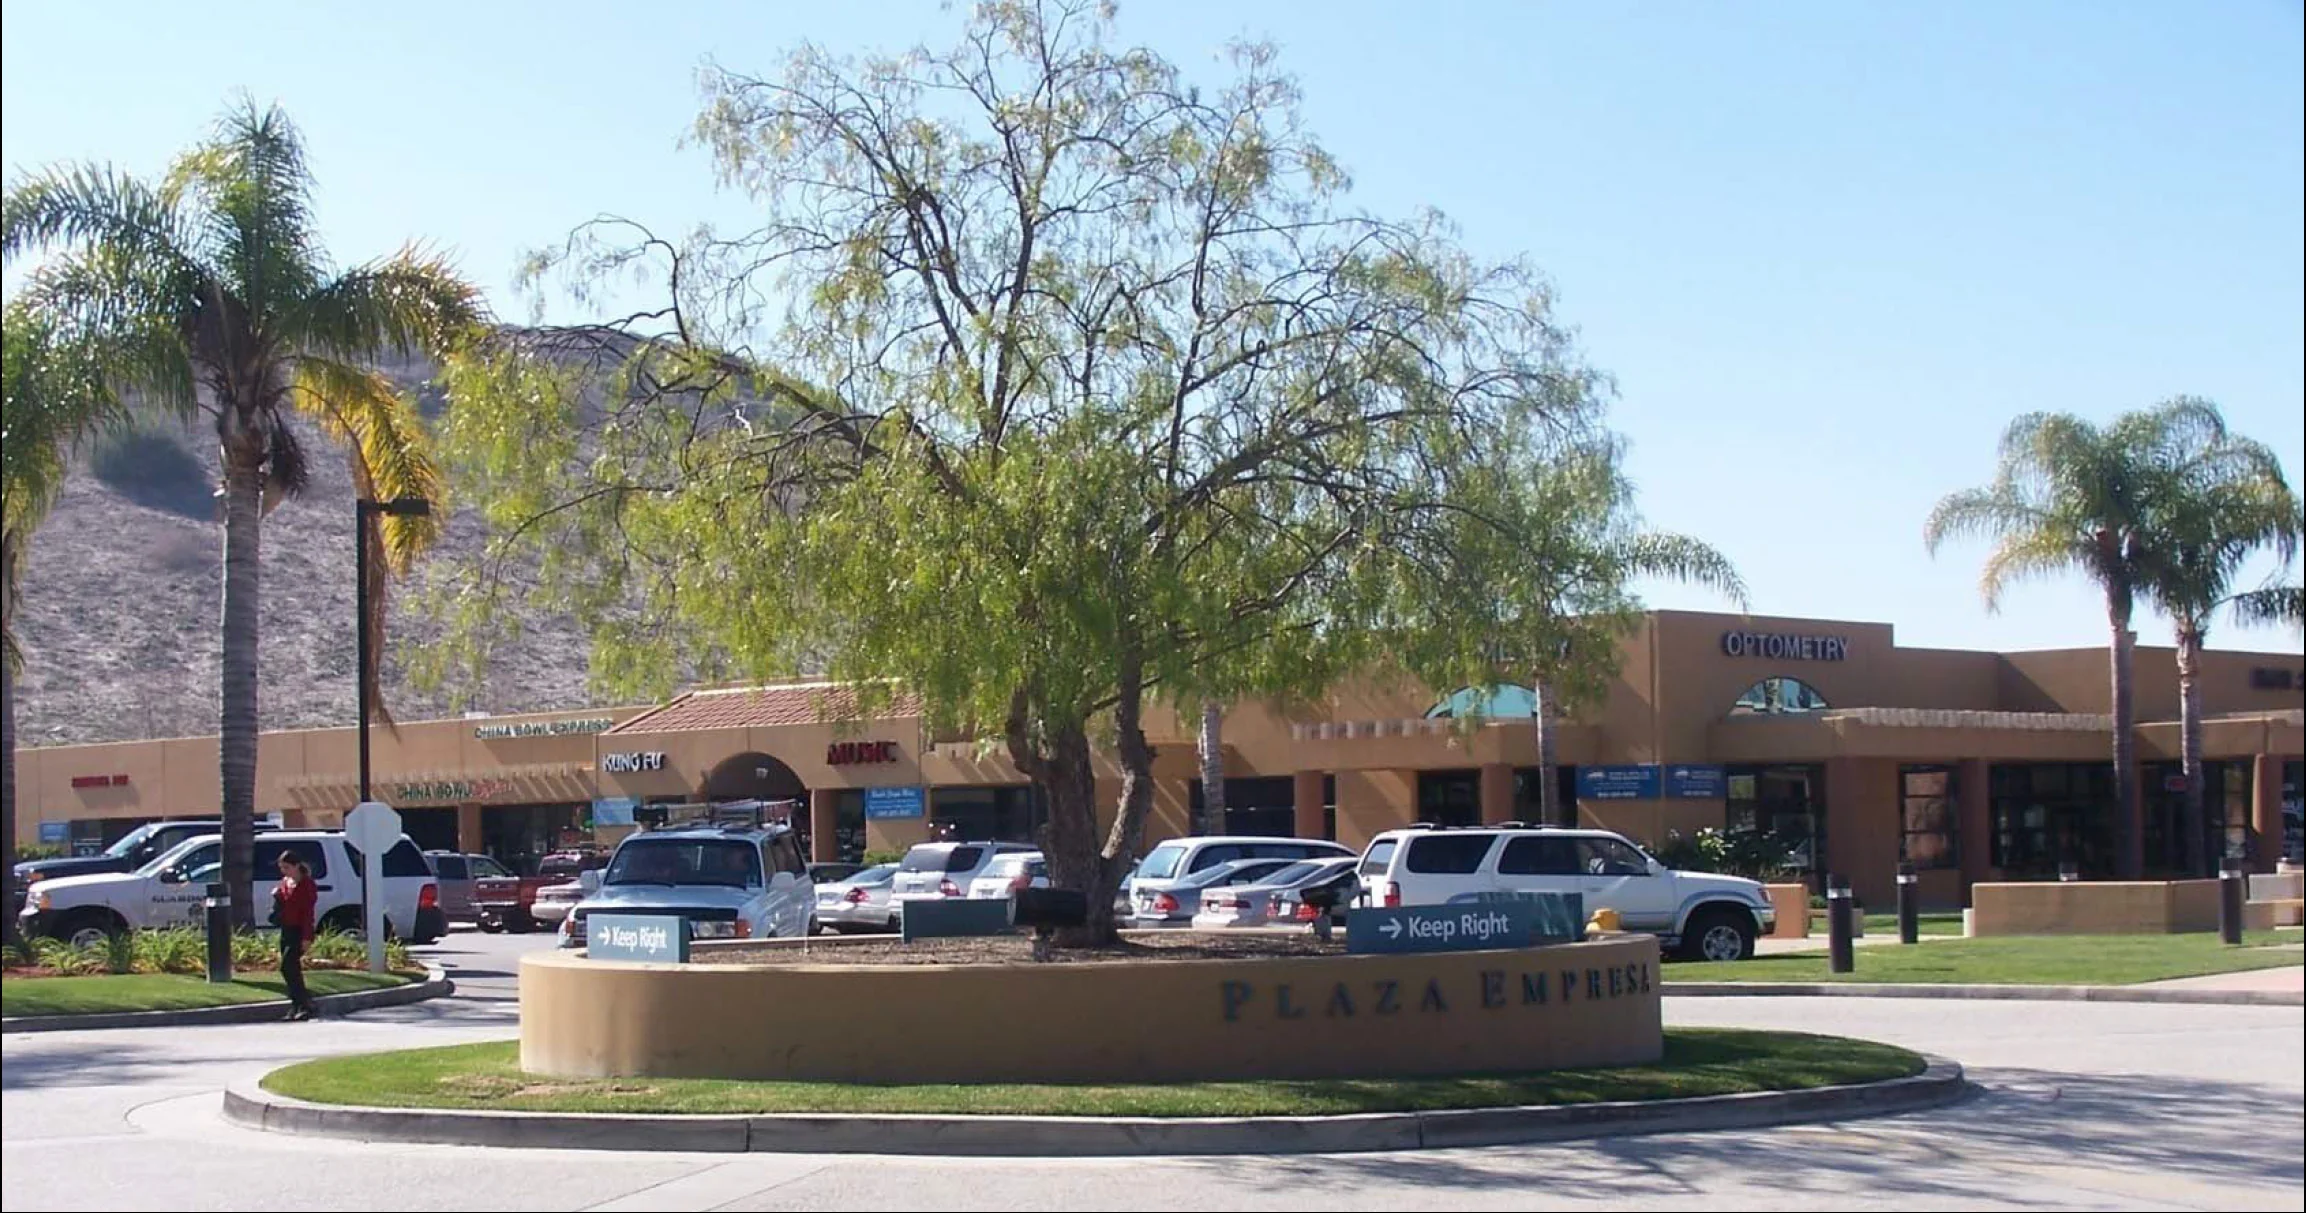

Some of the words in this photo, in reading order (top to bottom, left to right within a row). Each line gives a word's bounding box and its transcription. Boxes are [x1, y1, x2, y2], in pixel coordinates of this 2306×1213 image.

[1721, 631, 1849, 660] OPTOMETRY
[475, 724, 516, 739] CHINA
[517, 721, 555, 737] BOWL
[602, 752, 642, 773] KUNG
[643, 751, 666, 770] FU
[827, 741, 897, 765] MUSIC
[397, 783, 433, 800] CHINA
[436, 780, 473, 799] BOWL
[1408, 915, 1455, 942] Keep
[1461, 910, 1510, 940] Right
[612, 926, 638, 953] Keep
[640, 925, 668, 954] Right
[1220, 977, 1449, 1022] PLAZA
[1479, 961, 1651, 1009] EMPRESA
